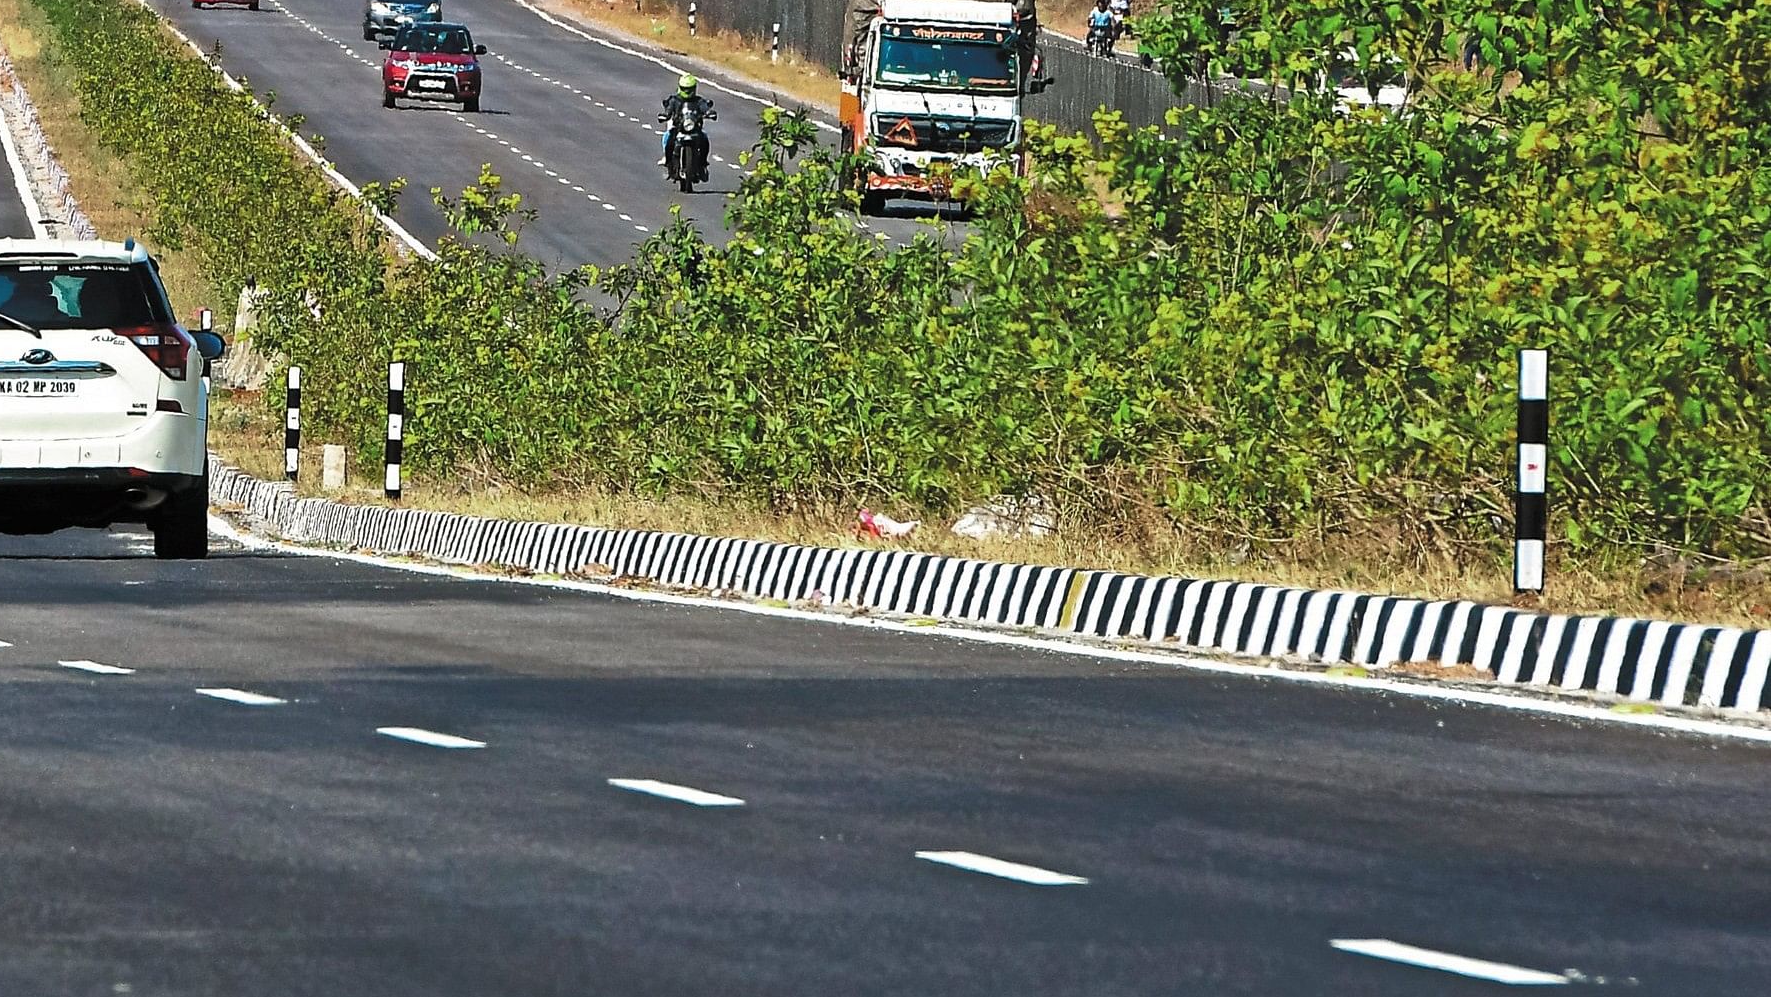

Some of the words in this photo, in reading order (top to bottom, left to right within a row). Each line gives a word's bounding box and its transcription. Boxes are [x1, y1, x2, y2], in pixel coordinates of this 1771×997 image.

[0, 380, 13, 393] KA
[15, 380, 30, 393] 02
[33, 380, 47, 393] MP
[50, 381, 76, 393] 2039
